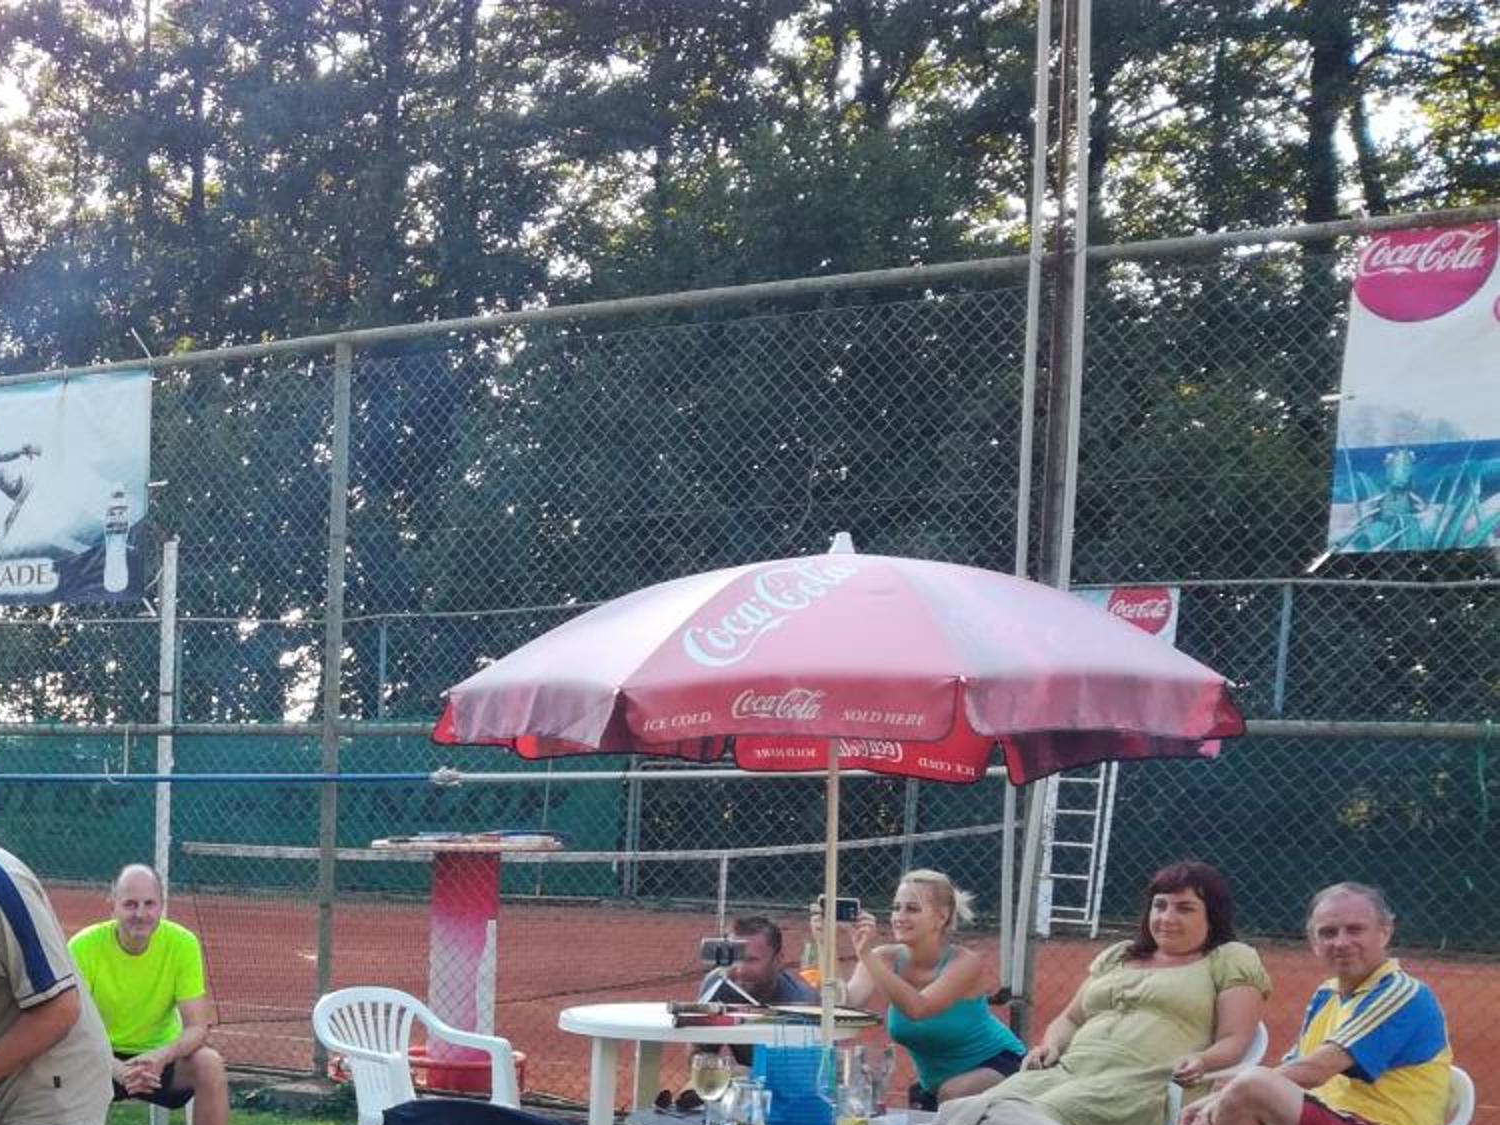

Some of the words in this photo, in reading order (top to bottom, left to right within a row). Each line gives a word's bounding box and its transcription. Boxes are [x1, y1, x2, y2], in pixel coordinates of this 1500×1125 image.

[643, 718, 667, 732] ICE
[670, 711, 712, 729] COLD
[840, 709, 882, 723] SOLD
[884, 712, 925, 727] HERE
